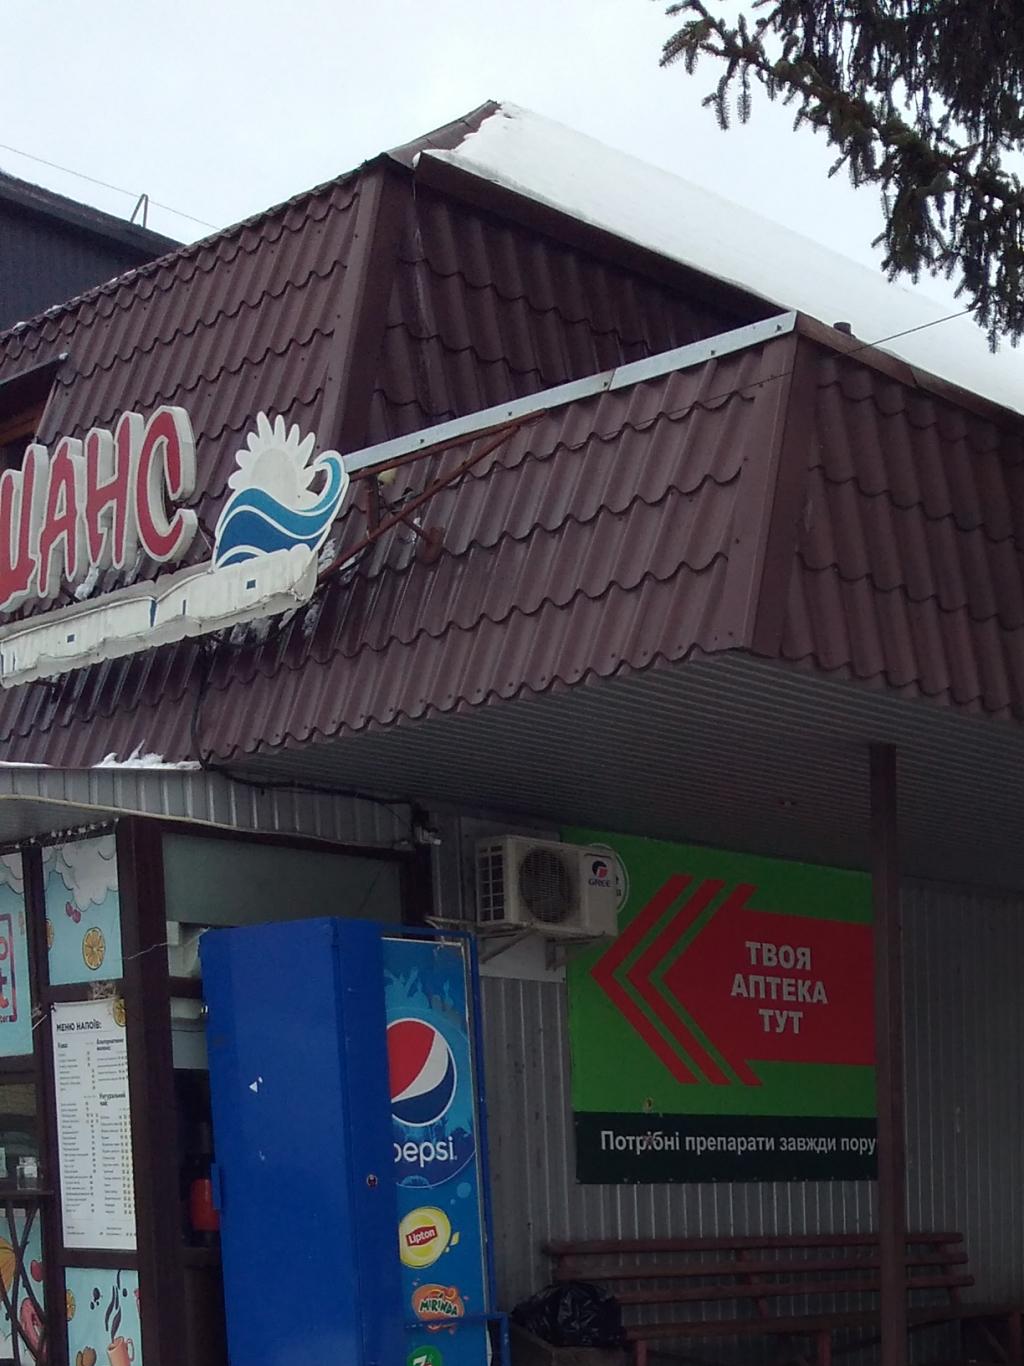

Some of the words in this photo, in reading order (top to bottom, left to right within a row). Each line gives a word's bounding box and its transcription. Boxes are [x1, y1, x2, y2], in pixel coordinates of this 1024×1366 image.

[745, 941, 812, 970] ТВОЯ
[731, 973, 829, 1005] АПТЕКА
[56, 1023, 75, 1032] МЕНЮ
[758, 1008, 804, 1034] ТУТ
[600, 1130, 680, 1155] Потрібні
[685, 1135, 775, 1155] препарати
[780, 1137, 837, 1153] завжди
[841, 1137, 877, 1155] пору
[408, 1229, 436, 1245] Lipton
[419, 1297, 459, 1317] MIRINDA
